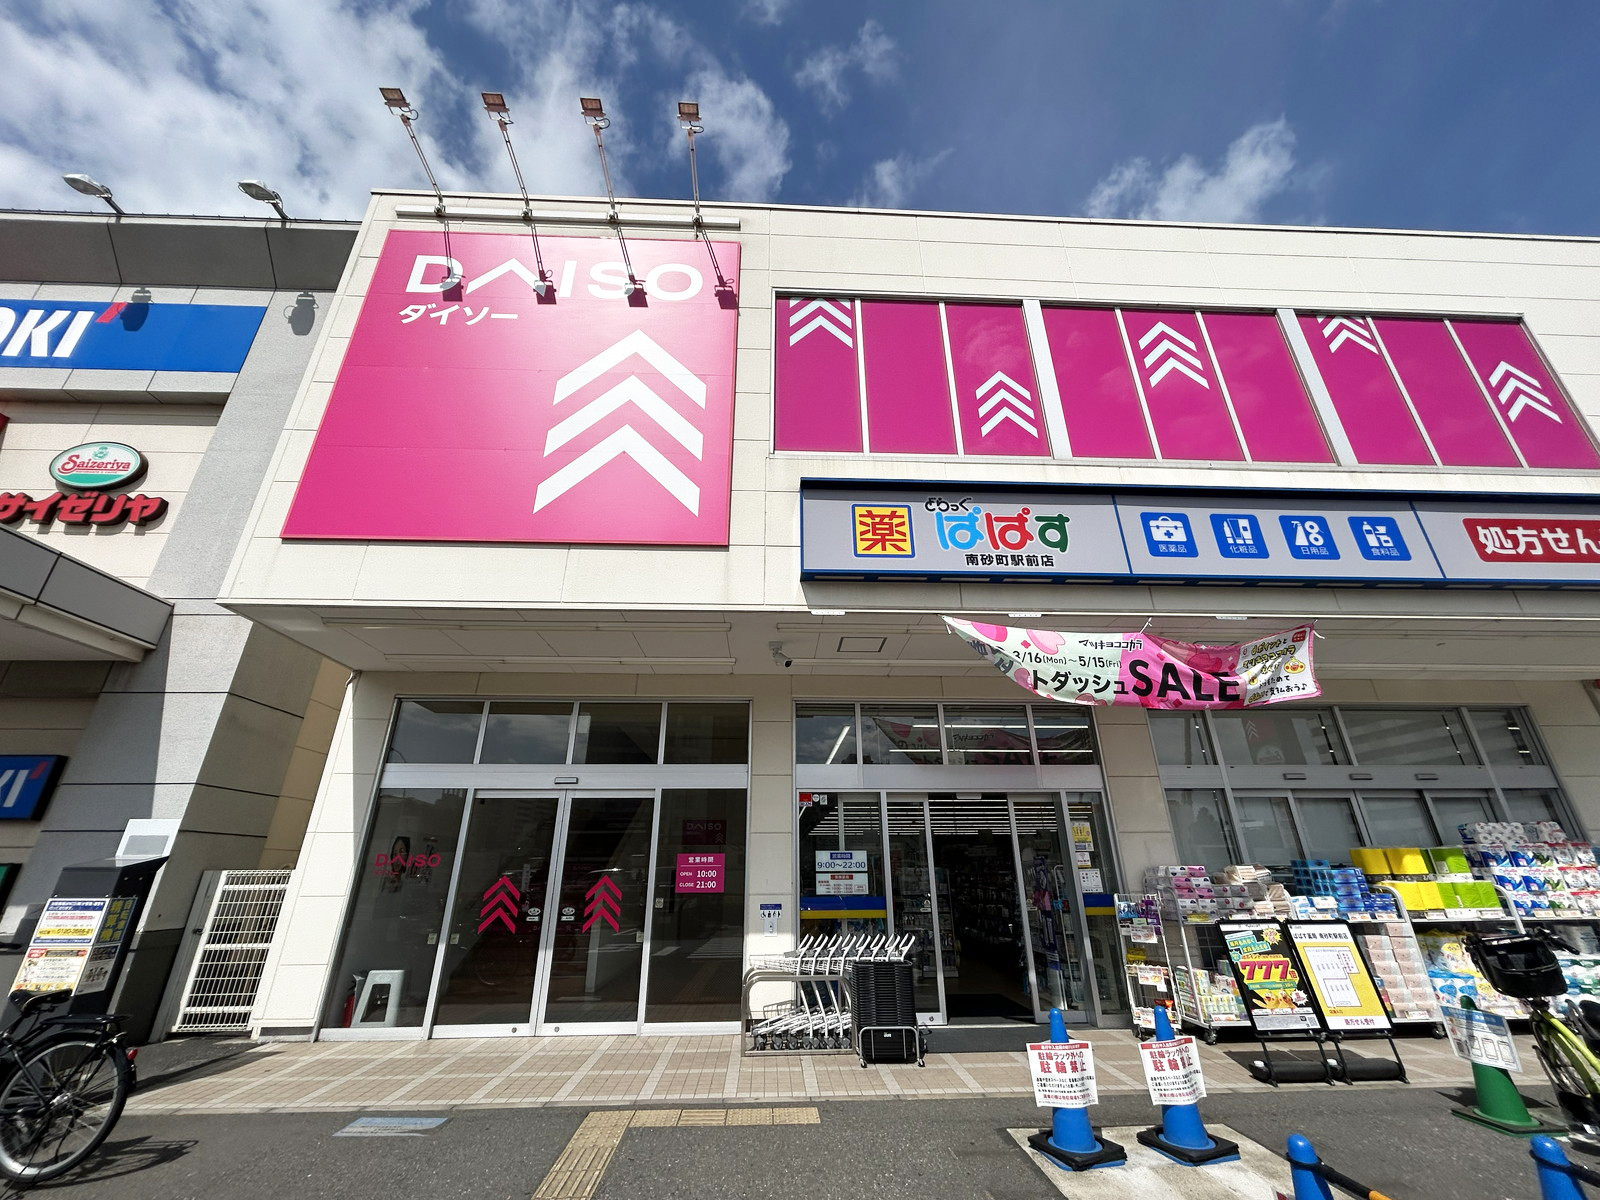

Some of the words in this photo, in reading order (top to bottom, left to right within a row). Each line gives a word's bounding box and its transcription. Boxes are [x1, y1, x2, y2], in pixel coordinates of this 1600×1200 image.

[405, 254, 704, 302] DAISO
[398, 302, 519, 326] ダイソー
[57, 454, 131, 474] Saizeriya
[0, 491, 164, 524] サイゼリヤ
[924, 497, 972, 512] どらっぐ
[858, 509, 907, 552] 薬
[935, 506, 1070, 553] ぱぱす
[1476, 525, 1600, 555] 処方せん
[1158, 544, 1187, 554] 医薬品
[1229, 545, 1258, 554] 化粧品
[1300, 546, 1329, 555] 日用品
[1371, 547, 1400, 556] 食料品
[965, 553, 1055, 567] 南砂町駅前店
[1078, 639, 1143, 652] マツキヨココカラ
[1128, 659, 1241, 702] SALE
[374, 853, 443, 868] DAISO
[696, 870, 717, 878] 10:00
[695, 881, 717, 889] 21:00
[1037, 1051, 1084, 1061] 駐輪ラック外への
[1039, 1059, 1087, 1074] 駐輪禁止
